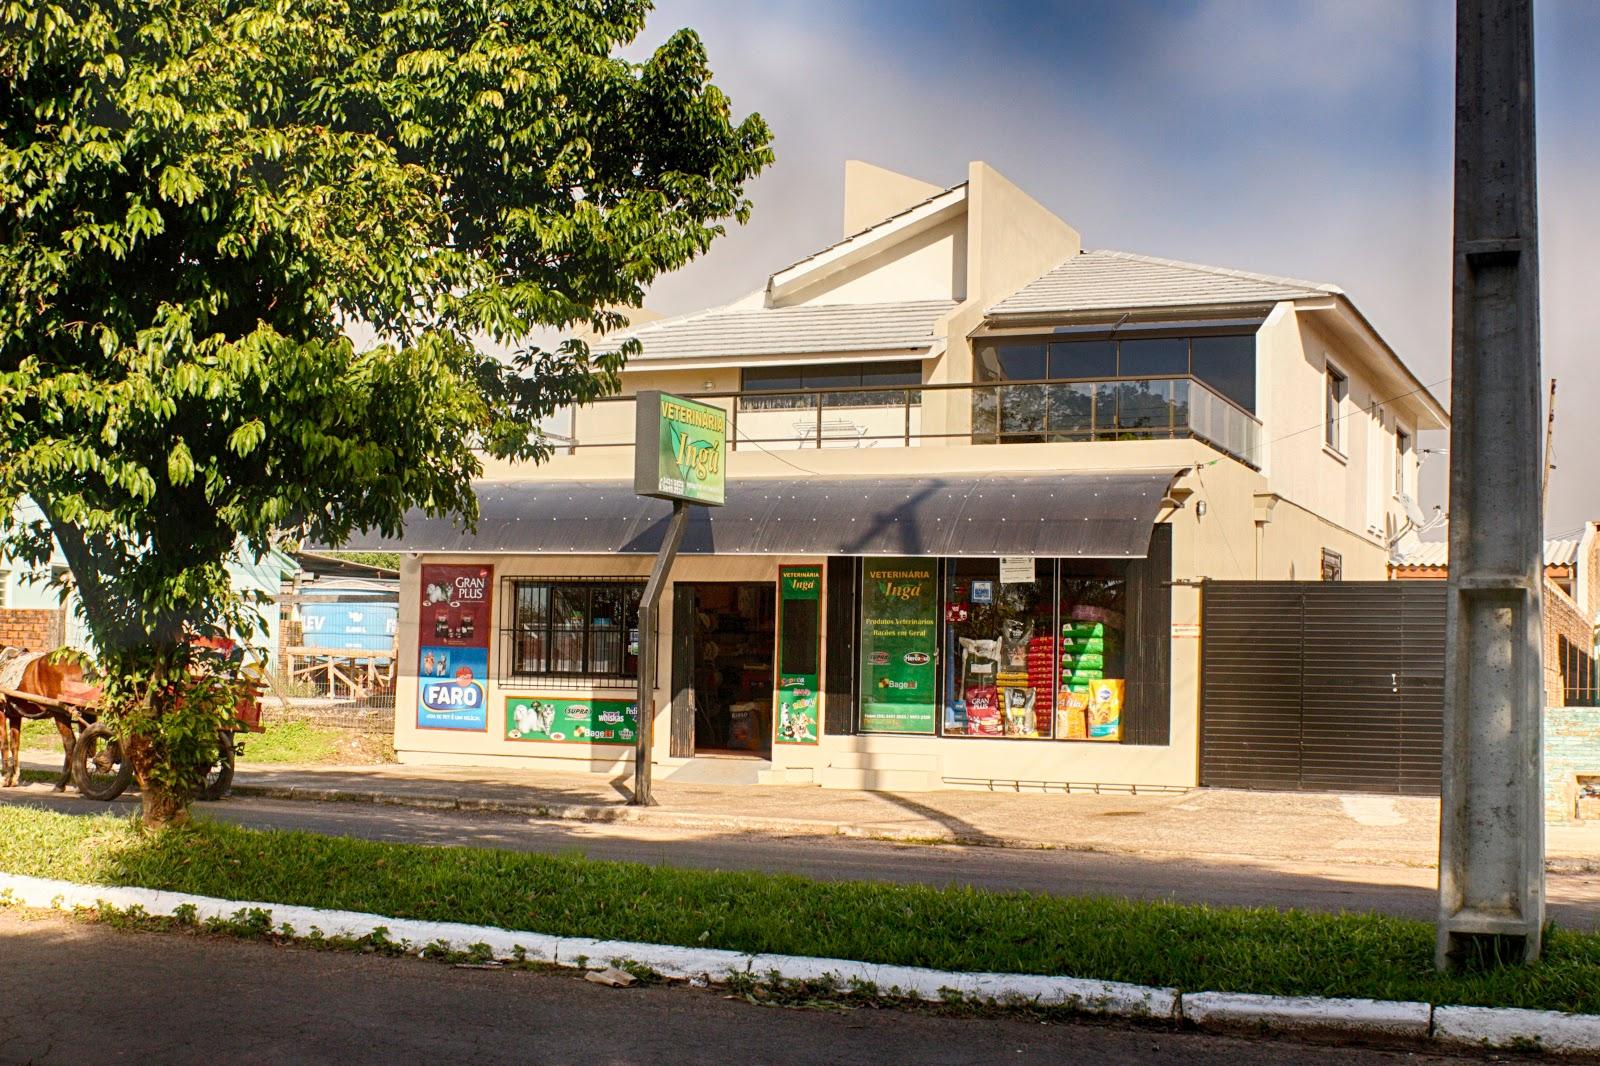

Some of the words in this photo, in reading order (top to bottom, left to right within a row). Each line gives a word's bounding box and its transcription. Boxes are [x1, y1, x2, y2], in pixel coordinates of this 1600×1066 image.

[661, 400, 724, 433] VETERINÁRIA
[676, 432, 720, 480] Ingá
[870, 569, 929, 578] VETERINÁRIA
[455, 577, 485, 588] GRAN
[792, 579, 816, 591] Ingá
[458, 588, 483, 599] PLUS
[885, 582, 921, 600] Ingá
[428, 686, 477, 706] FARO
[598, 714, 624, 722] whiskas
